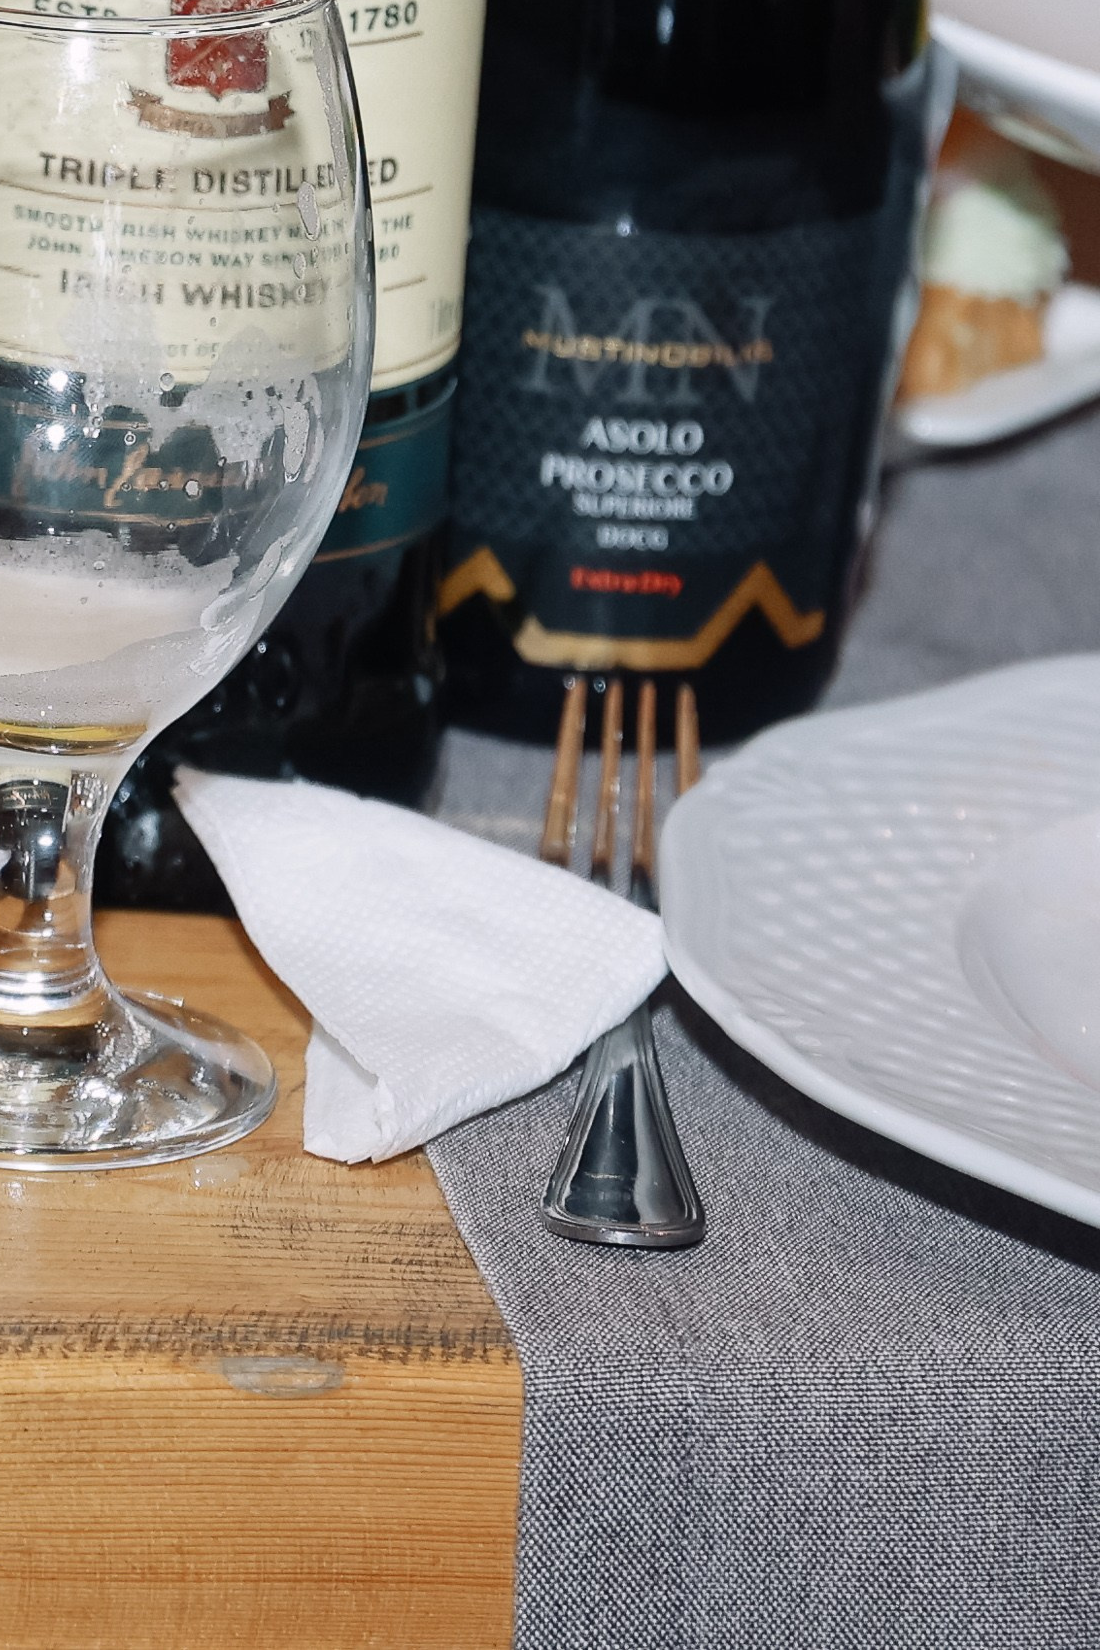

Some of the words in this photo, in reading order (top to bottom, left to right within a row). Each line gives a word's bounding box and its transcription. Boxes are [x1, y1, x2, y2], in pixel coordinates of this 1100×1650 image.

[348, 0, 418, 33] 1780
[39, 151, 178, 192] TRIPLE
[27, 236, 82, 254] JOHN
[116, 223, 177, 243] RISH
[580, 415, 704, 455] ASOLO
[540, 452, 734, 497] PROSECCO
